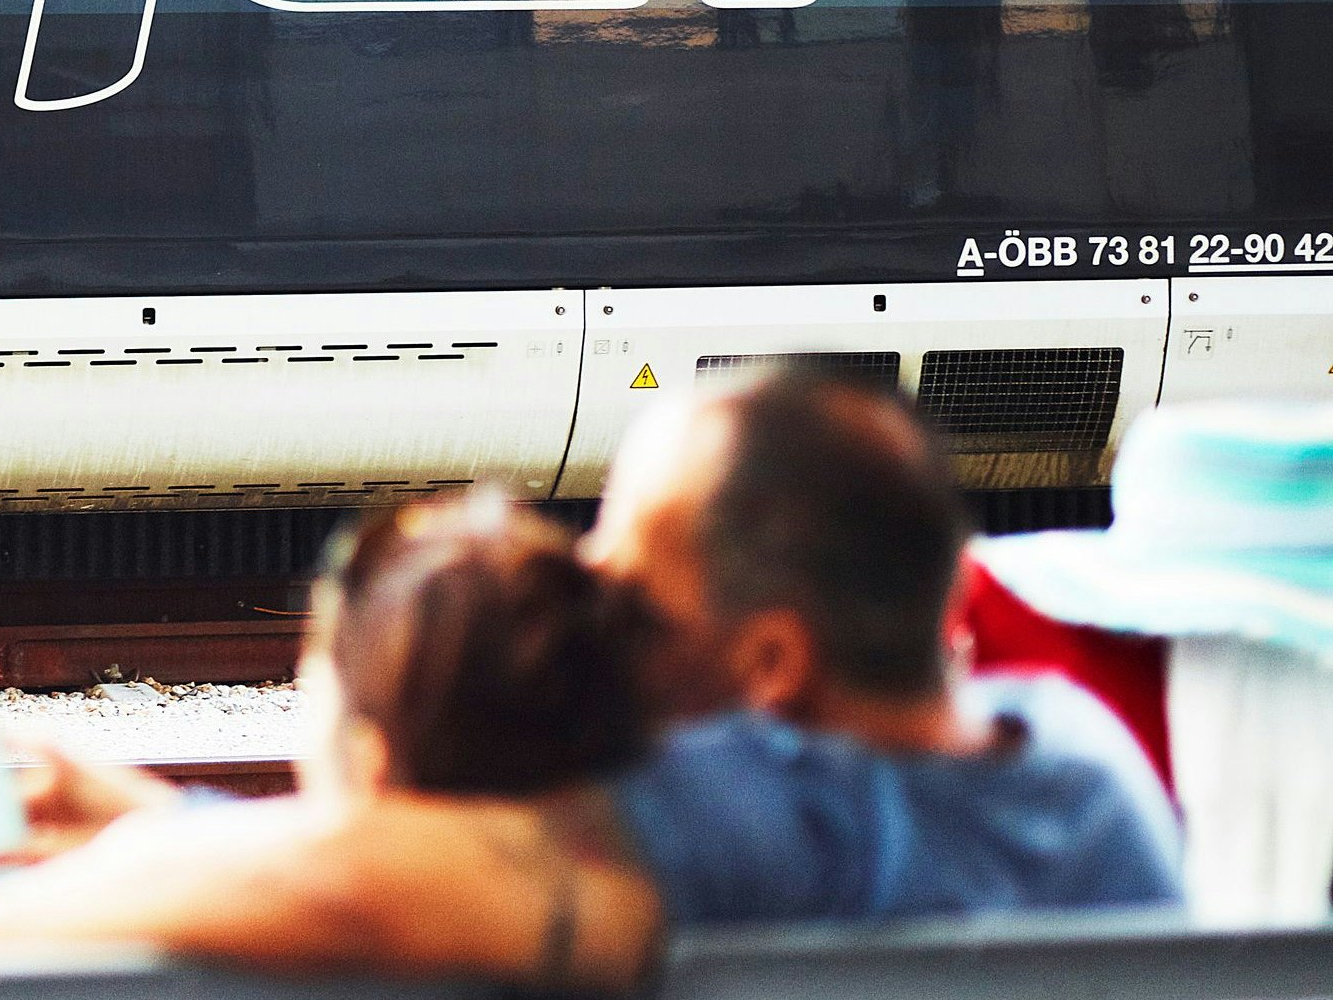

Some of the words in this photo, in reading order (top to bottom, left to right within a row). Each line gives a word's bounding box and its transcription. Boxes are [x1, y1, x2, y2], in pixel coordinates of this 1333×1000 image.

[957, 230, 1078, 277] A-ÖBB
[1088, 236, 1129, 266] 73
[1138, 235, 1175, 265] 81
[1189, 234, 1285, 264] 22-90
[1294, 232, 1333, 262] 42
